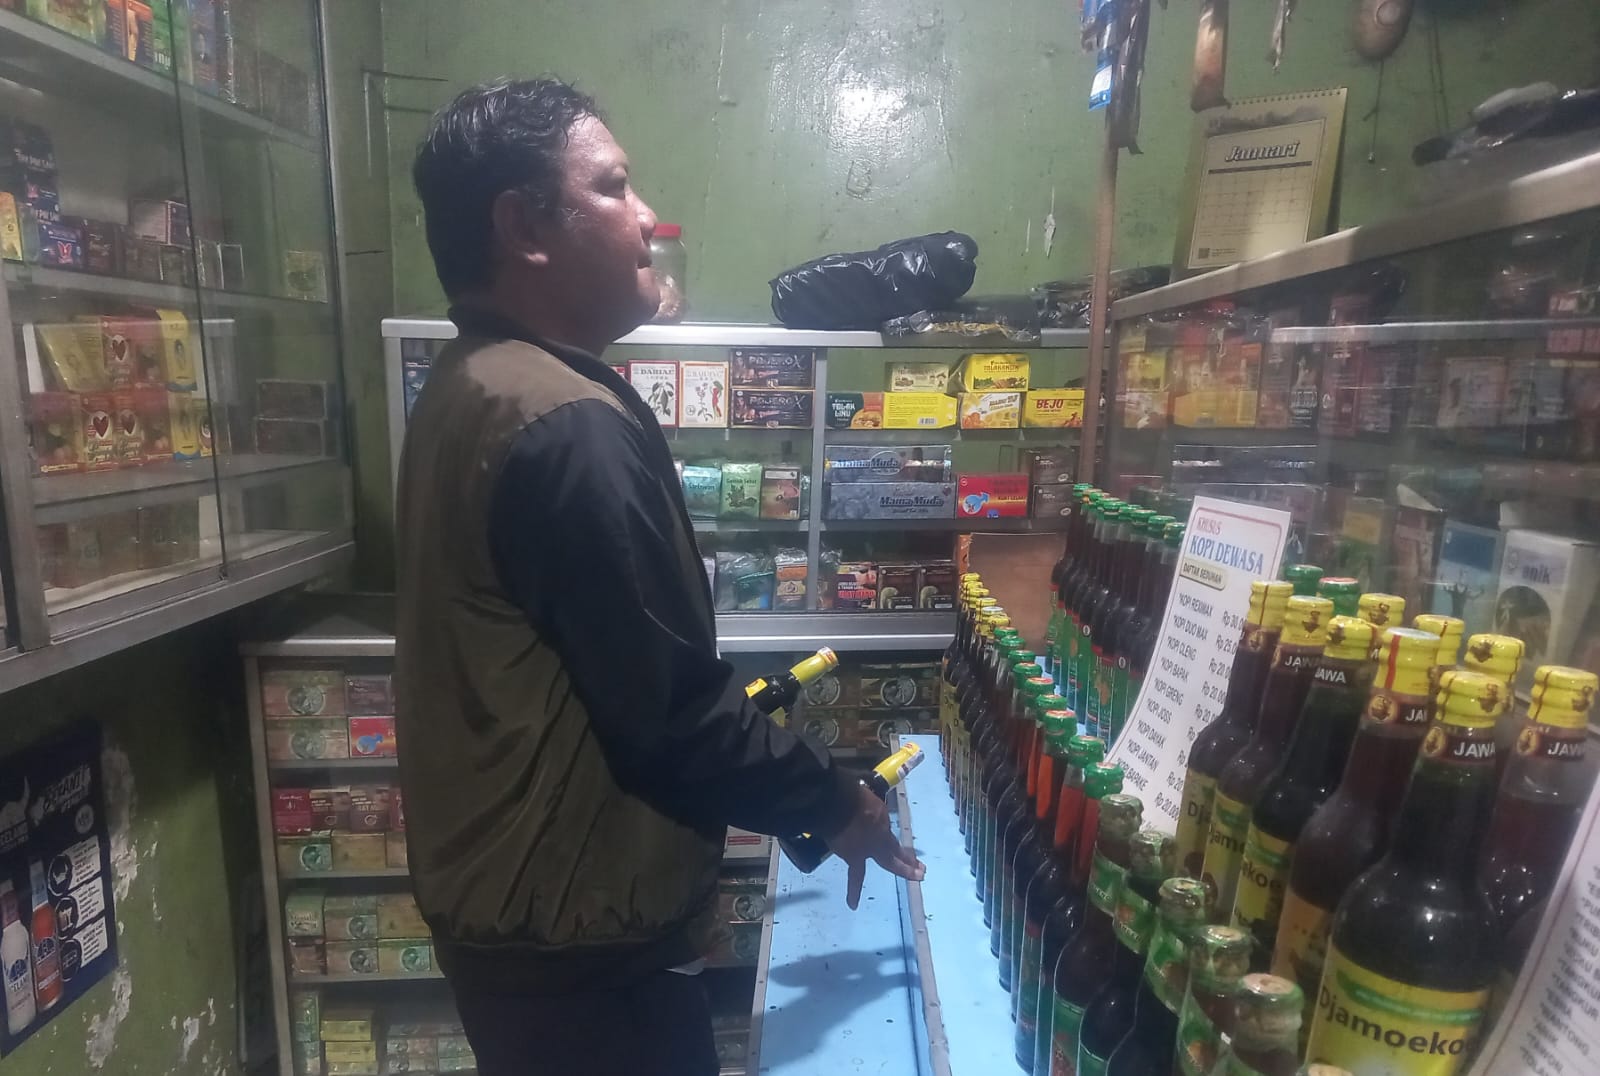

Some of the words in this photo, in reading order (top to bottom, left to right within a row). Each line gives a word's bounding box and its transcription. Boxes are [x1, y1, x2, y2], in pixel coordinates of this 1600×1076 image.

[1225, 140, 1300, 162] Januari
[1036, 399, 1064, 409] BEJO
[1189, 535, 1215, 560] KOPI
[1215, 541, 1264, 576] DEWASA
[1223, 610, 1231, 627] Rp
[1216, 634, 1224, 652] Rp
[1154, 792, 1164, 808] Rp
